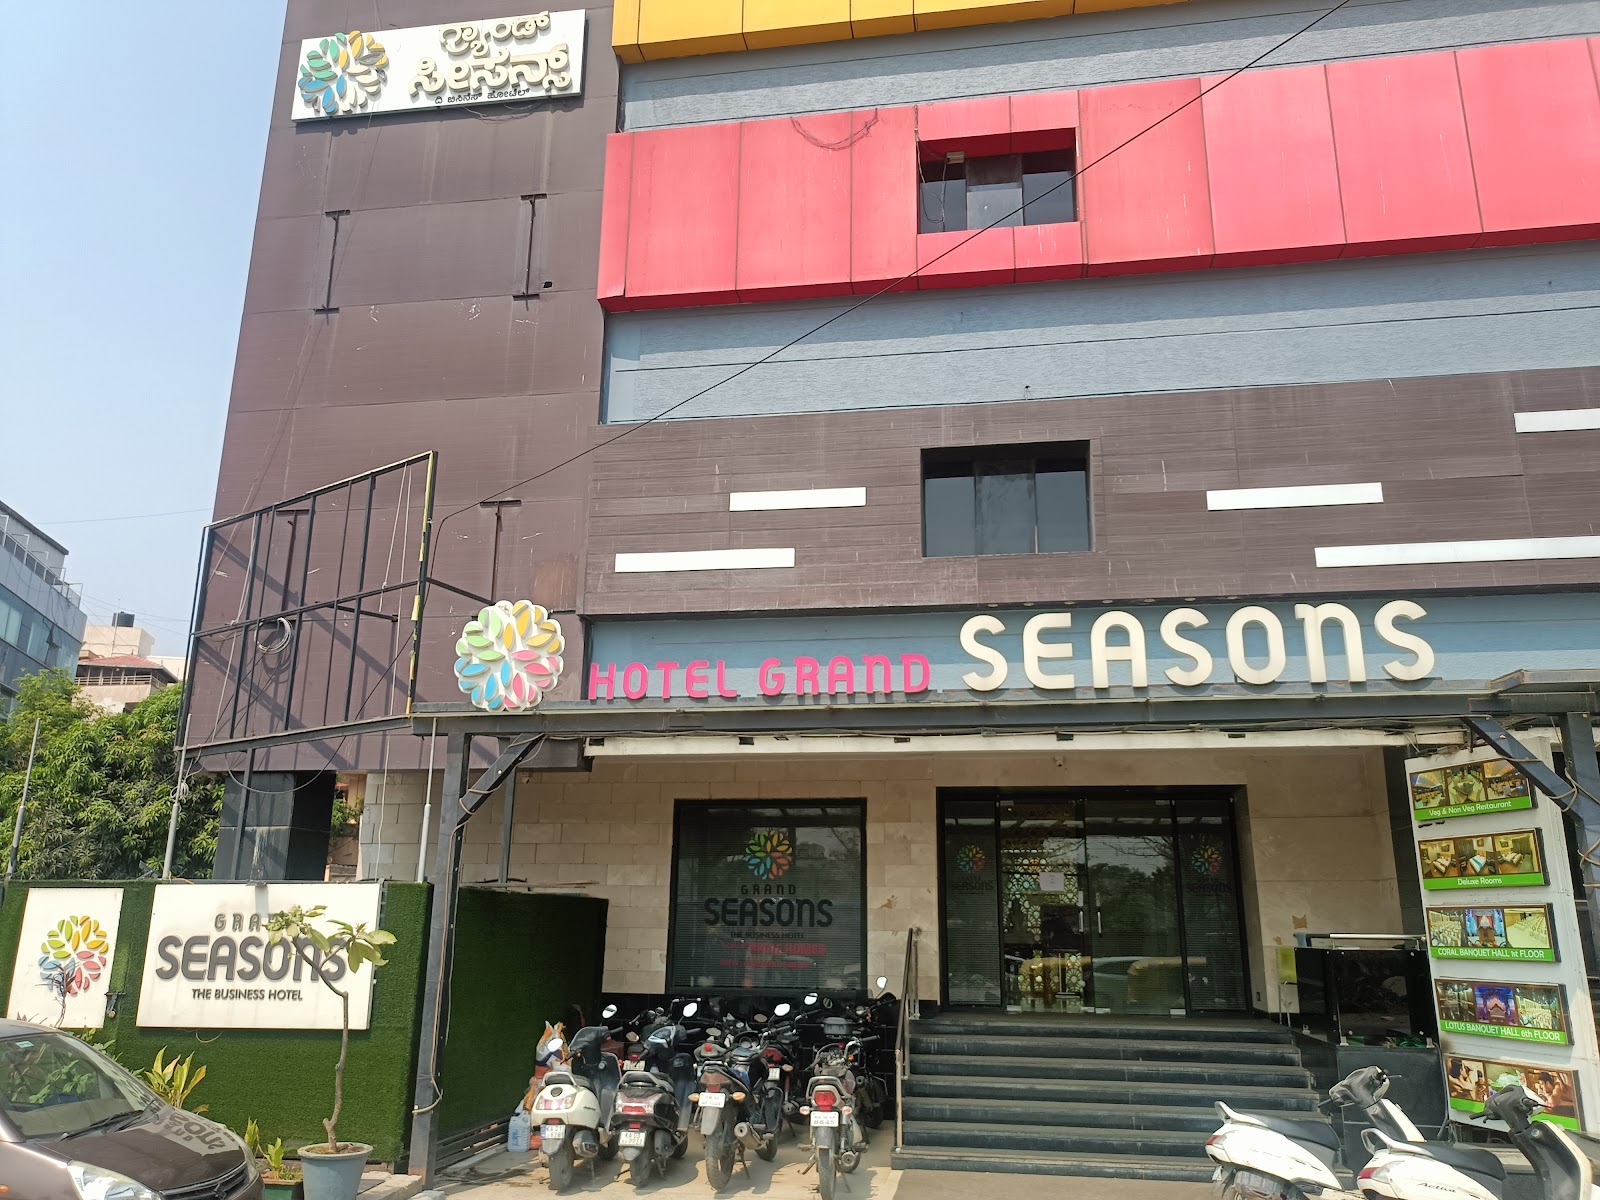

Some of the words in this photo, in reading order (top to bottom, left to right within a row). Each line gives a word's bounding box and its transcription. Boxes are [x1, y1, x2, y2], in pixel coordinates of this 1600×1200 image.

[434, 96, 444, 104] ದಿ
[588, 658, 740, 700] HOTEL
[758, 653, 931, 697] GRAND
[959, 599, 1436, 692] SEASONS
[1449, 806, 1461, 814] Non
[1476, 800, 1512, 810] Restaurant
[1458, 878, 1479, 886] Deluxe
[1480, 877, 1502, 885] Rooms
[740, 884, 797, 895] GRAND
[704, 897, 833, 928] SEASONS
[155, 935, 347, 983] SEASONS
[1437, 948, 1459, 956] CORAL
[1460, 948, 1490, 957] BANQUET
[1491, 949, 1510, 957] HALL
[1520, 950, 1545, 958] FLOOR
[192, 988, 211, 1001] THE
[214, 988, 266, 1001] BUSINESS
[268, 989, 303, 1002] HOTEL
[1444, 1021, 1466, 1030] LOTUS
[1466, 1023, 1499, 1034] BANQUET
[1500, 1027, 1520, 1037] HALL
[1521, 1030, 1533, 1038] 6th
[1534, 1031, 1561, 1041] FLOOR
[1417, 1182, 1457, 1193] Activa
